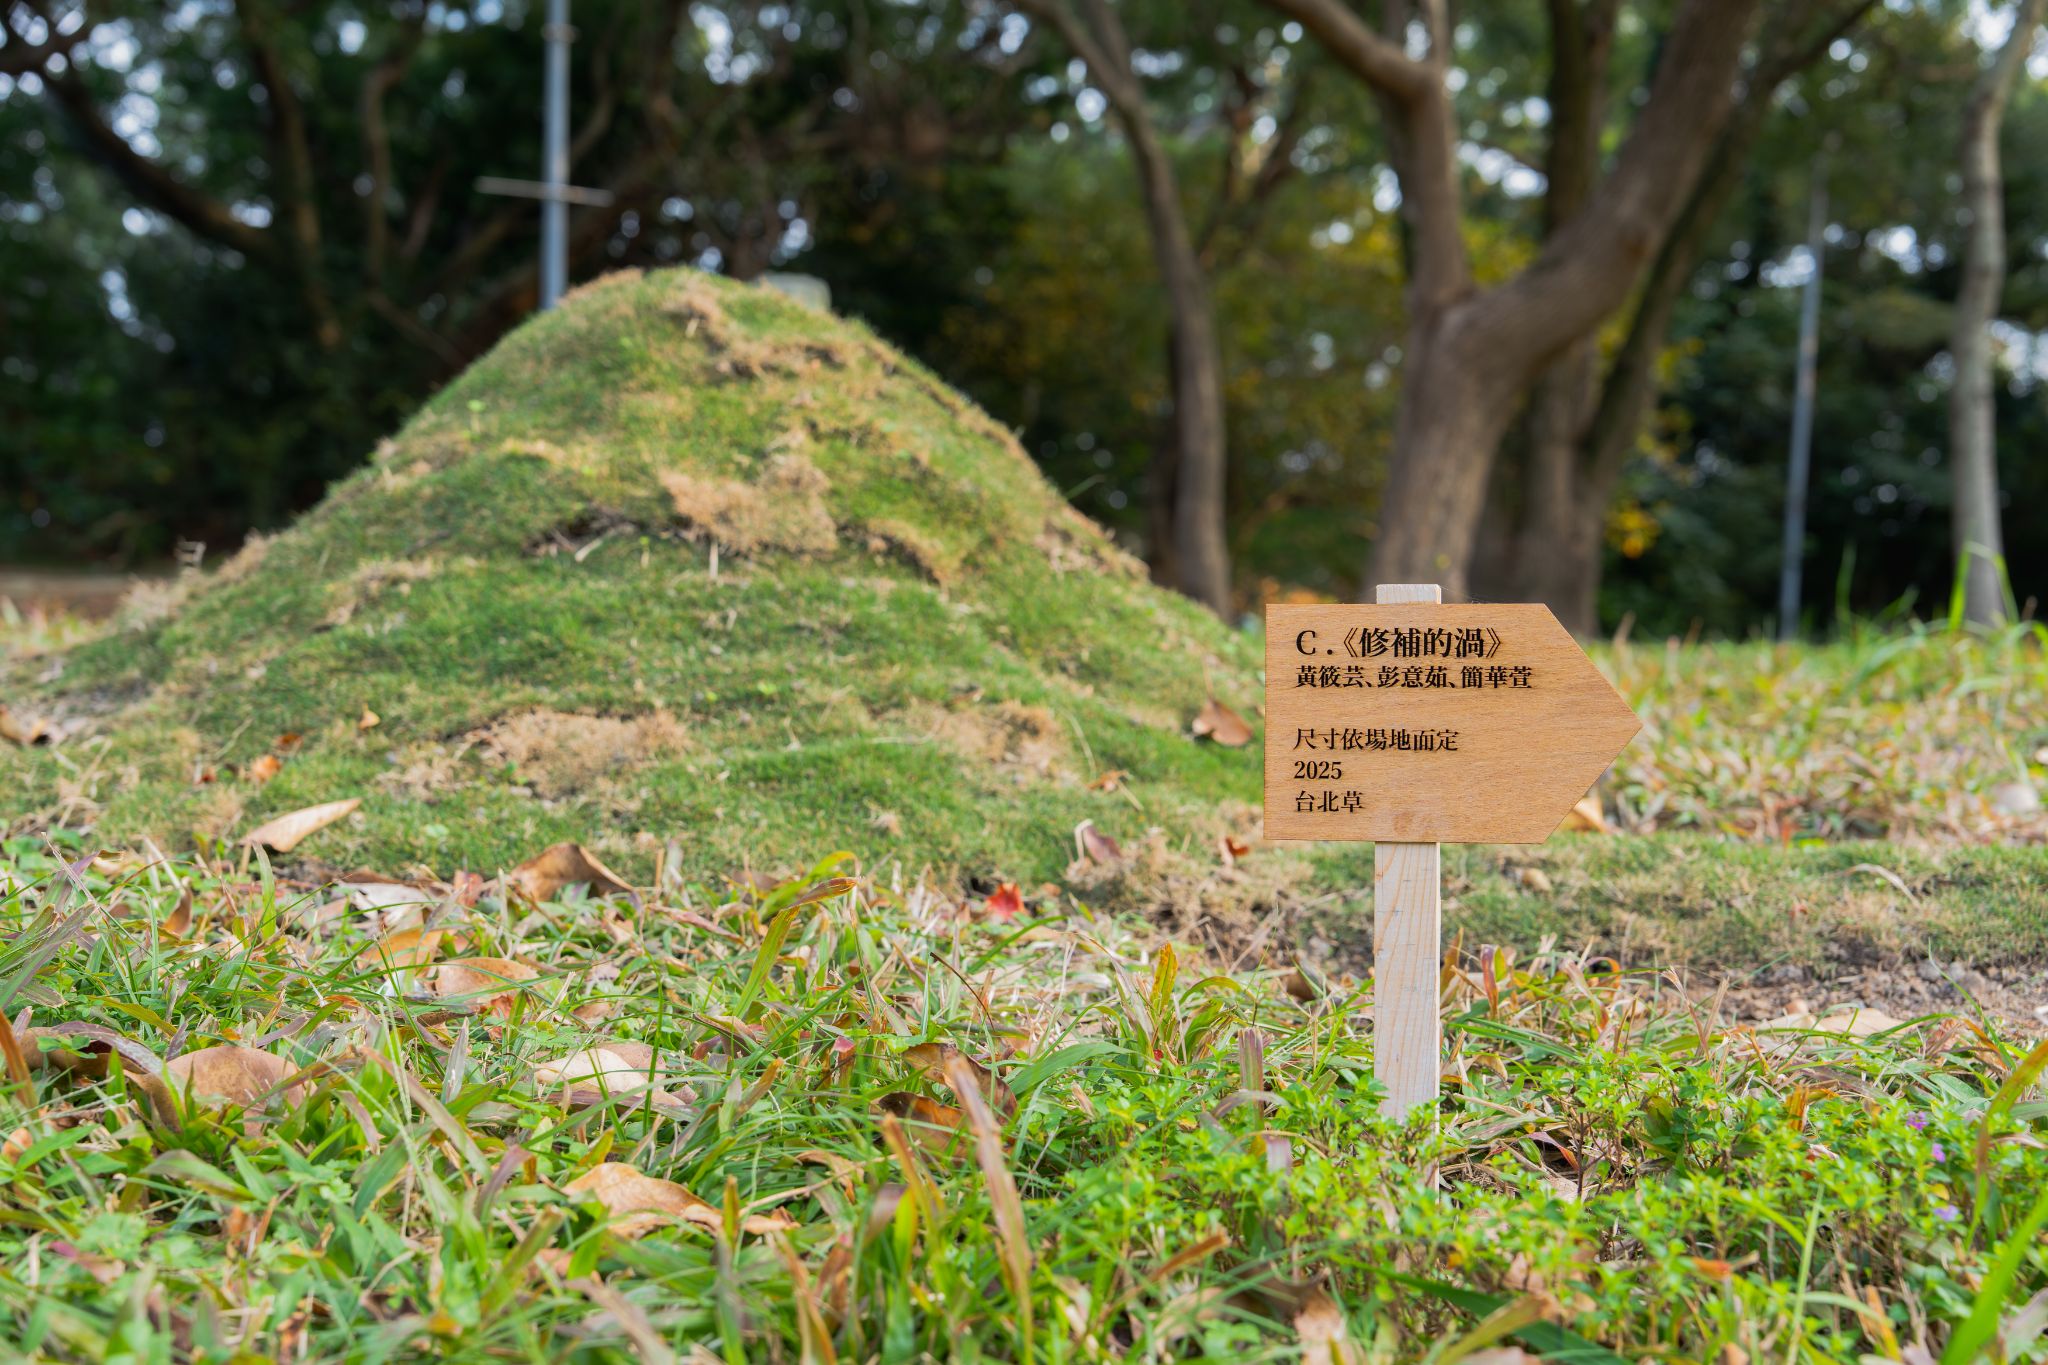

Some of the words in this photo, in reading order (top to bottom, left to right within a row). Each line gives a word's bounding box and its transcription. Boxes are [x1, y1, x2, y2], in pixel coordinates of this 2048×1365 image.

[1293, 727, 1460, 752] 尺寸依場地而定
[1293, 760, 1343, 780] 2025
[1294, 790, 1365, 813] 台北草
